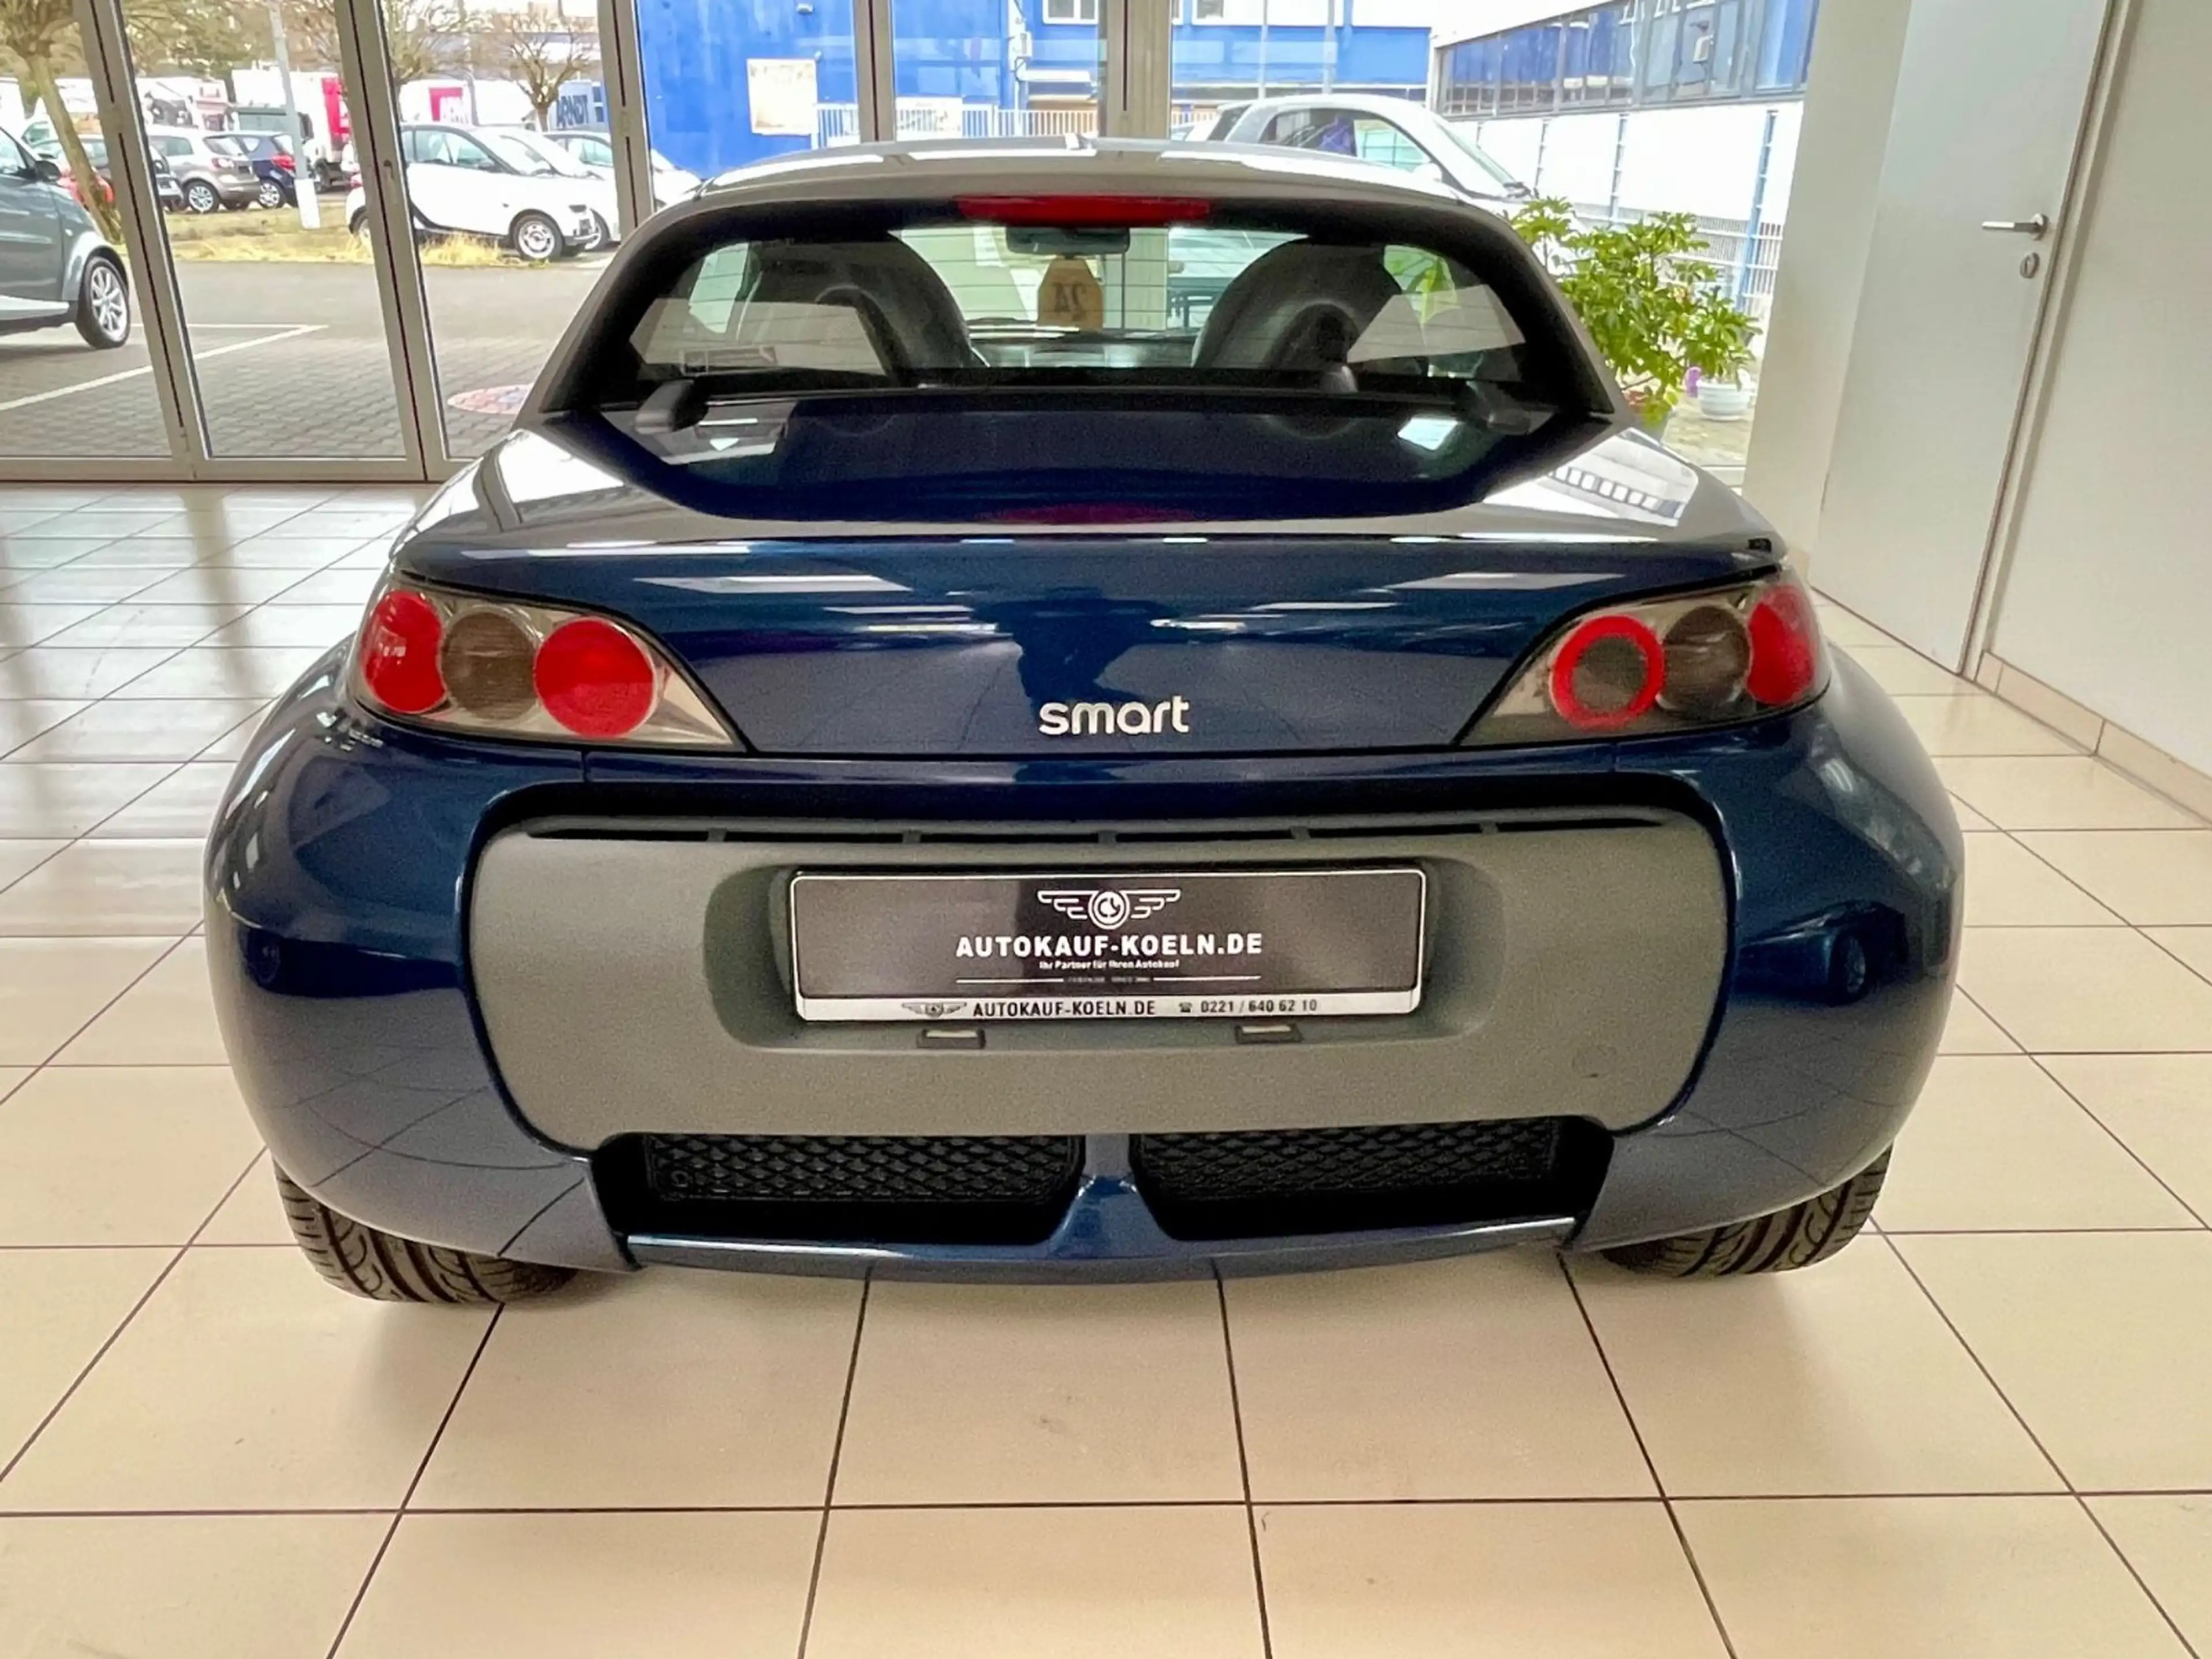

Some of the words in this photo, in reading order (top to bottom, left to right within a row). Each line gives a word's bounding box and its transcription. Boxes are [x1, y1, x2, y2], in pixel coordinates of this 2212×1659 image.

[1039, 695, 1190, 735] smart
[956, 933, 1262, 957] AUTOKAUF-KOELN.DE
[1039, 961, 1053, 969] Ihr
[1055, 960, 1091, 969] Partner
[1093, 960, 1107, 969] für
[1108, 960, 1135, 969] Ihren
[1135, 959, 1180, 969] Autokauf
[973, 1001, 1156, 1017] AUTOKAUF-KOELN.DE
[1200, 1000, 1234, 1013] 0221
[1248, 999, 1274, 1013] 640
[1278, 999, 1296, 1012] 62
[1302, 999, 1317, 1012] 10
